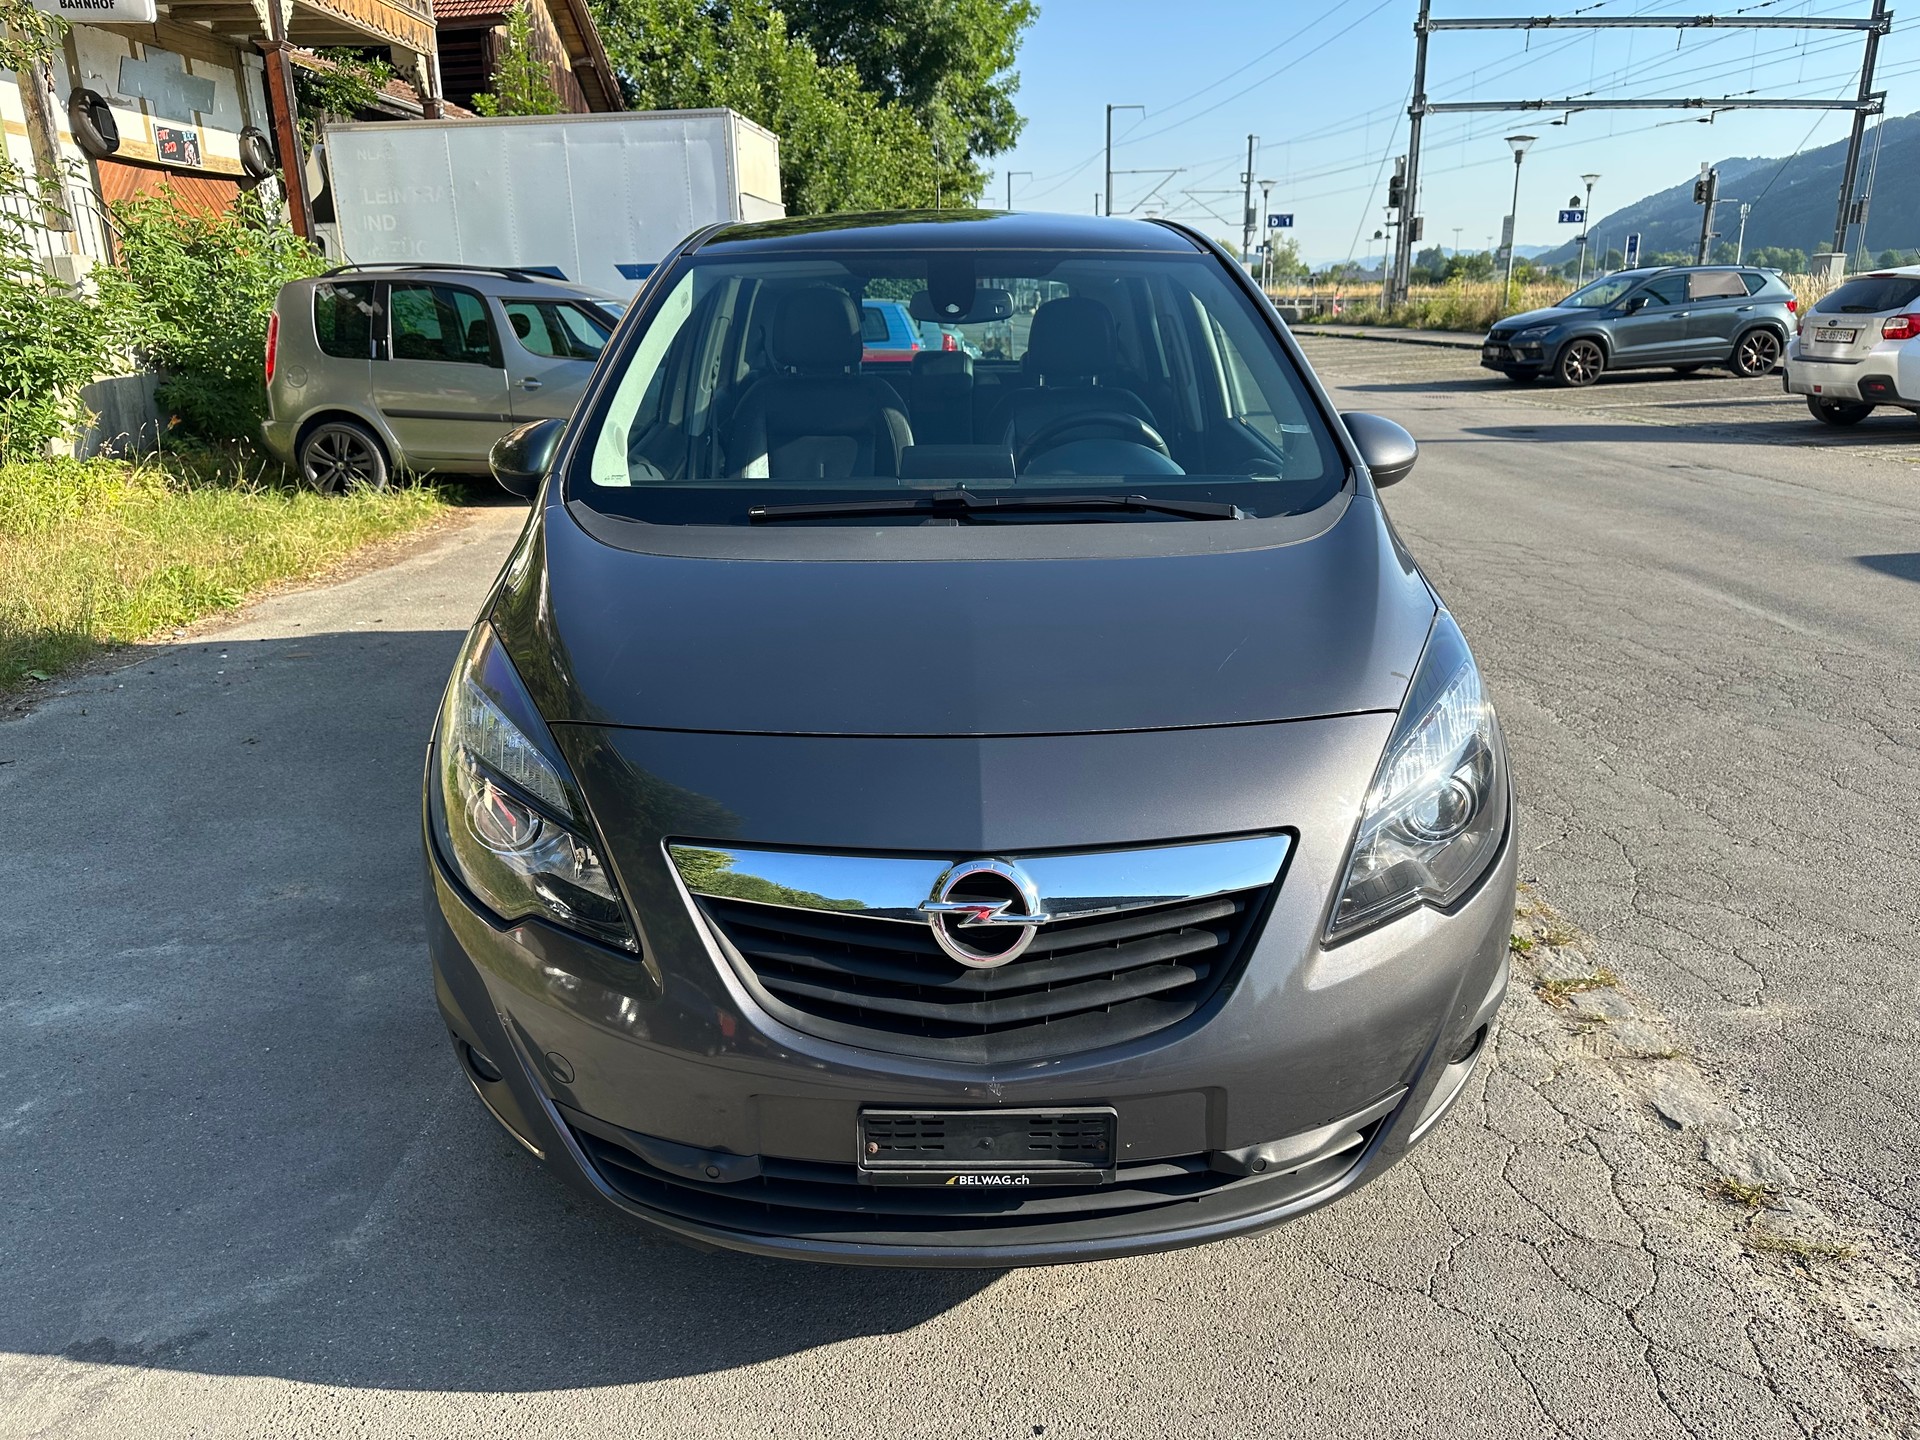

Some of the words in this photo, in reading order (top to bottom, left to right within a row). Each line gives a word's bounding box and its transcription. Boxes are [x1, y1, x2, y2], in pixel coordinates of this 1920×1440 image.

[59, 0, 115, 9] BAHNHOF
[1271, 217, 1279, 227] D
[959, 1175, 1030, 1185] BELWAG.ch
